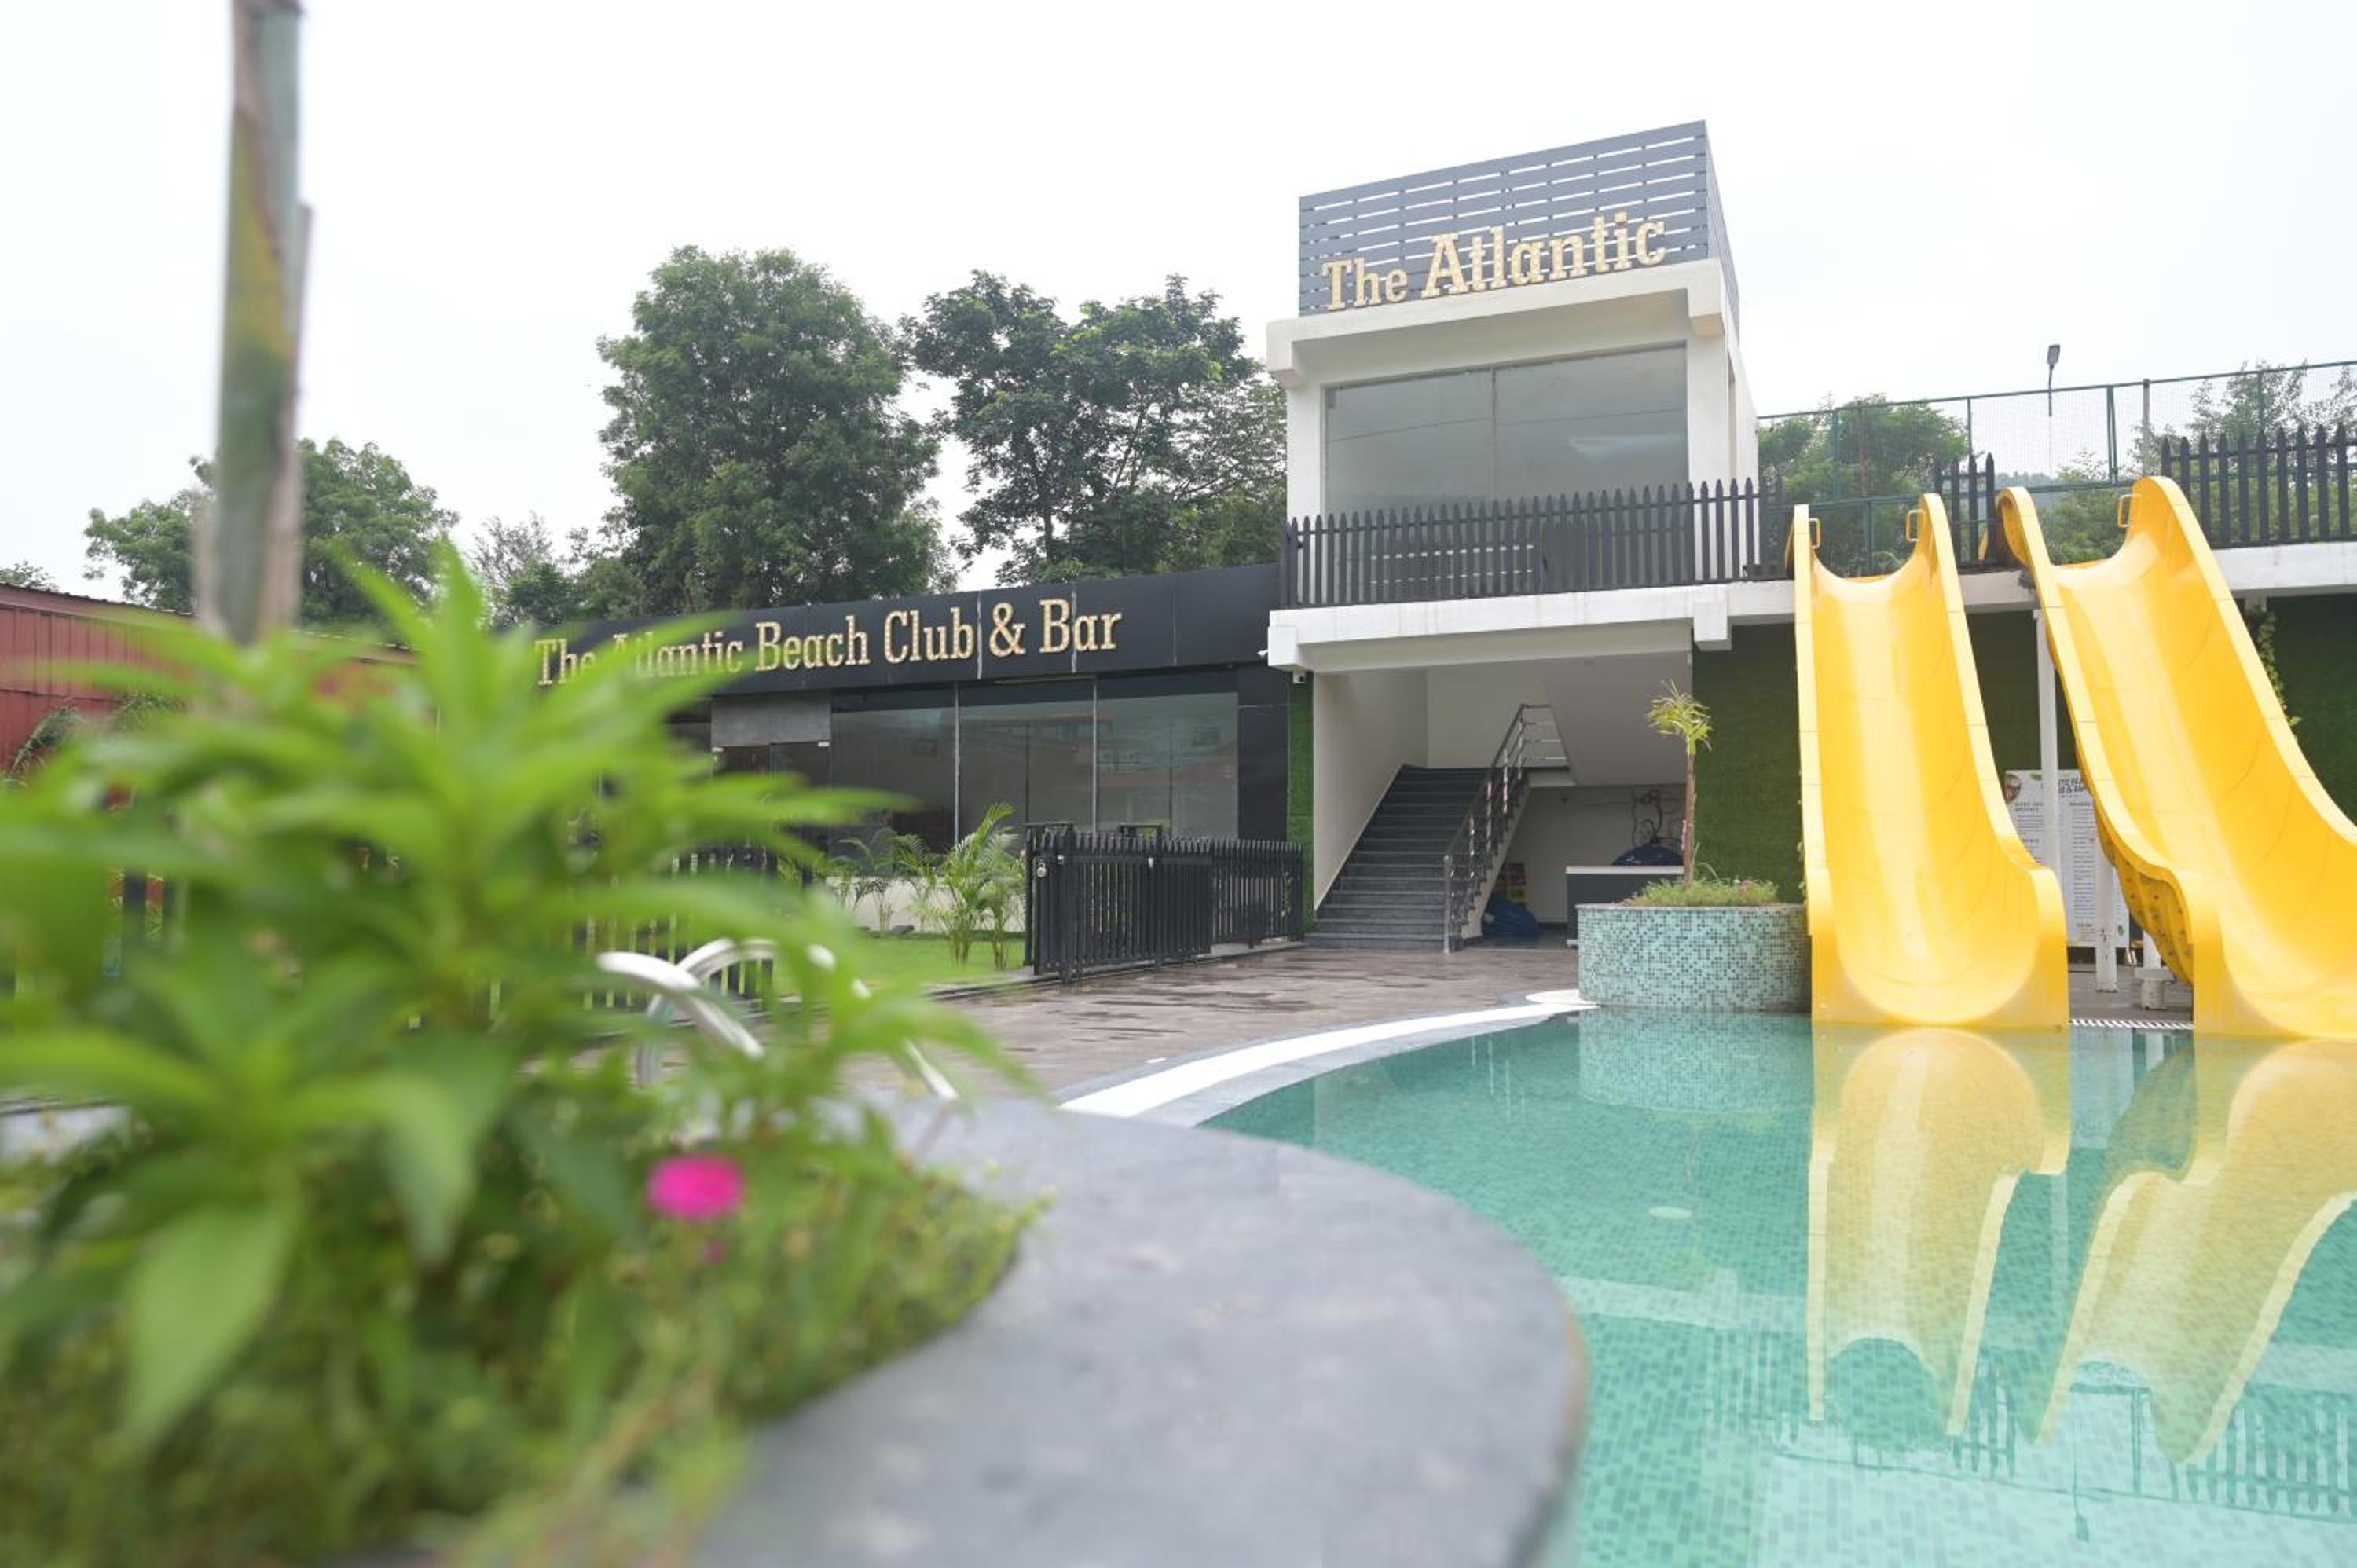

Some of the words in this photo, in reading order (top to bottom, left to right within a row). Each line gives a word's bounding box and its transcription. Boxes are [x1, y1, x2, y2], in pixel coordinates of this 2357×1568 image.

[1321, 257, 1409, 310] The
[1420, 211, 1666, 299] Atlantic
[533, 637, 596, 686] The
[754, 621, 871, 672] Beach
[883, 606, 976, 665] Club
[988, 602, 1026, 658] &
[1039, 597, 1123, 654] Bar
